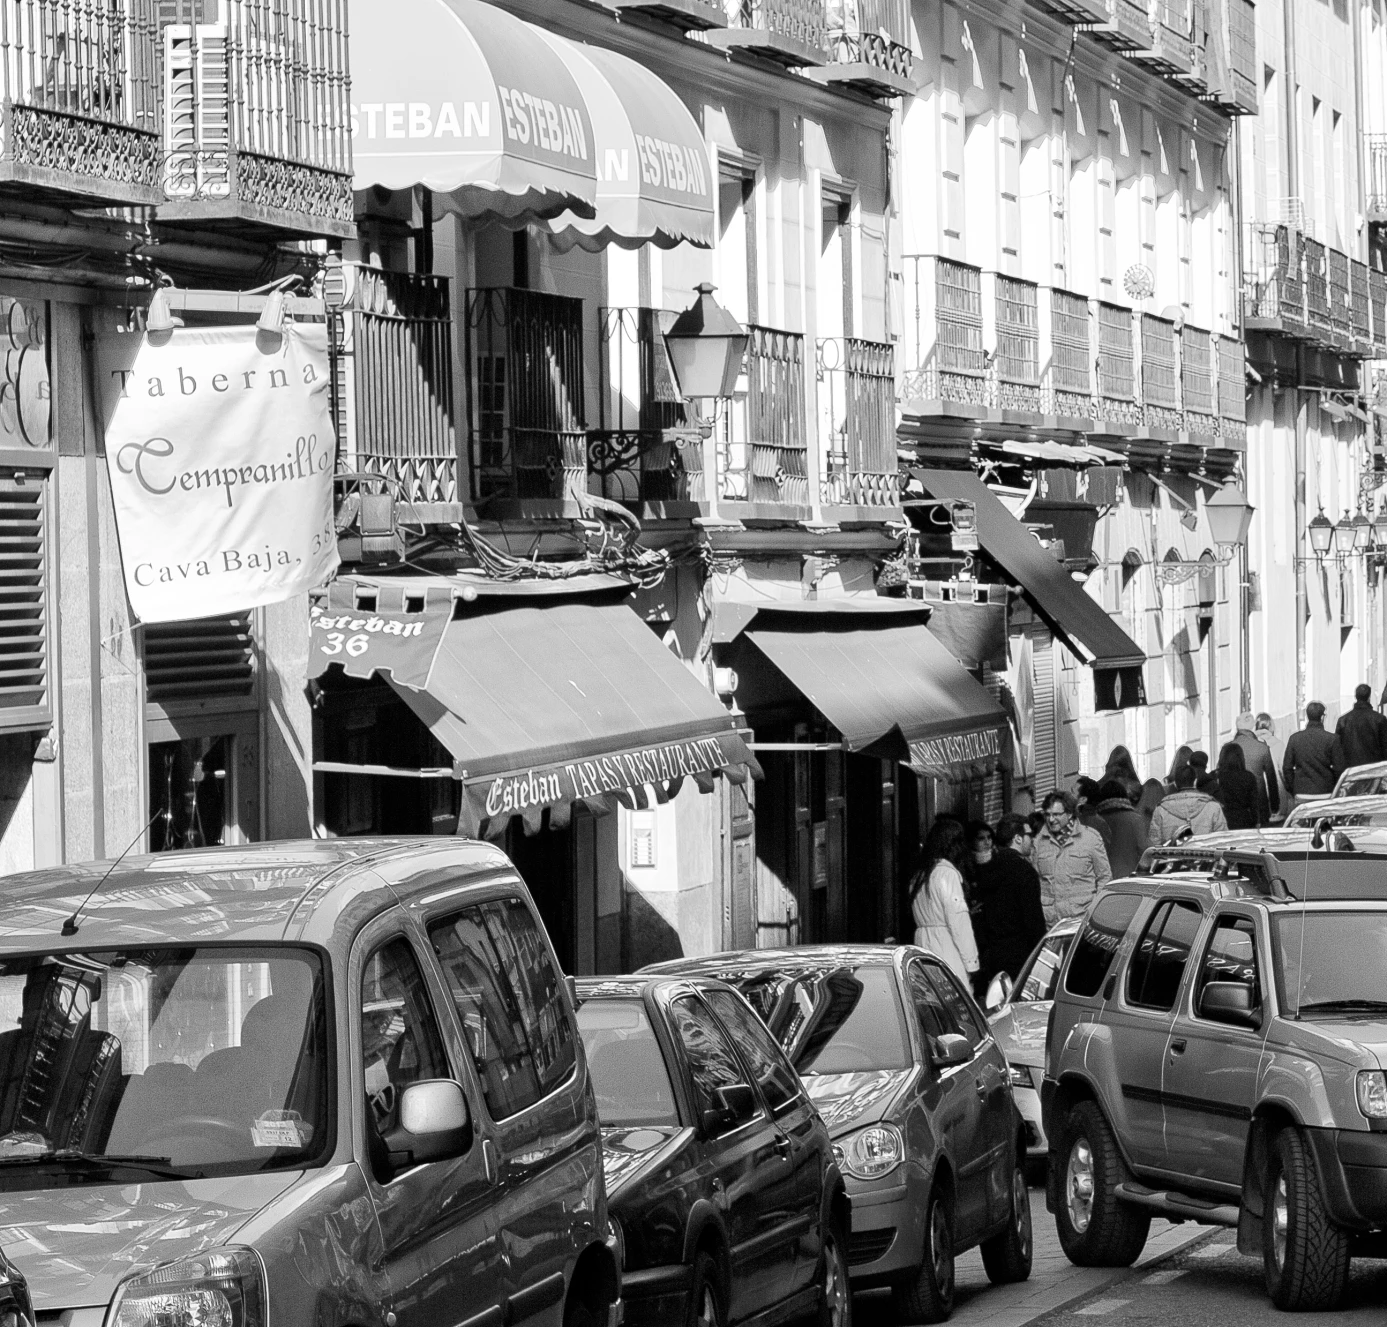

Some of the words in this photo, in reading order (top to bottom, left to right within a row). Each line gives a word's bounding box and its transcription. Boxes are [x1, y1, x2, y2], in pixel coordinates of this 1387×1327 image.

[499, 86, 588, 161] ESTEBAN
[636, 133, 707, 197] ESTEBAN
[111, 363, 318, 398] Taberna
[116, 433, 330, 508] Tempranillo
[134, 561, 212, 587] Cava
[220, 544, 302, 573] Baja,
[320, 632, 370, 658] 36
[943, 728, 1001, 763] RESTAURANTE
[485, 769, 562, 817] Esteban
[565, 756, 622, 800] TAPAS
[622, 737, 730, 787] RESTAURANTE
